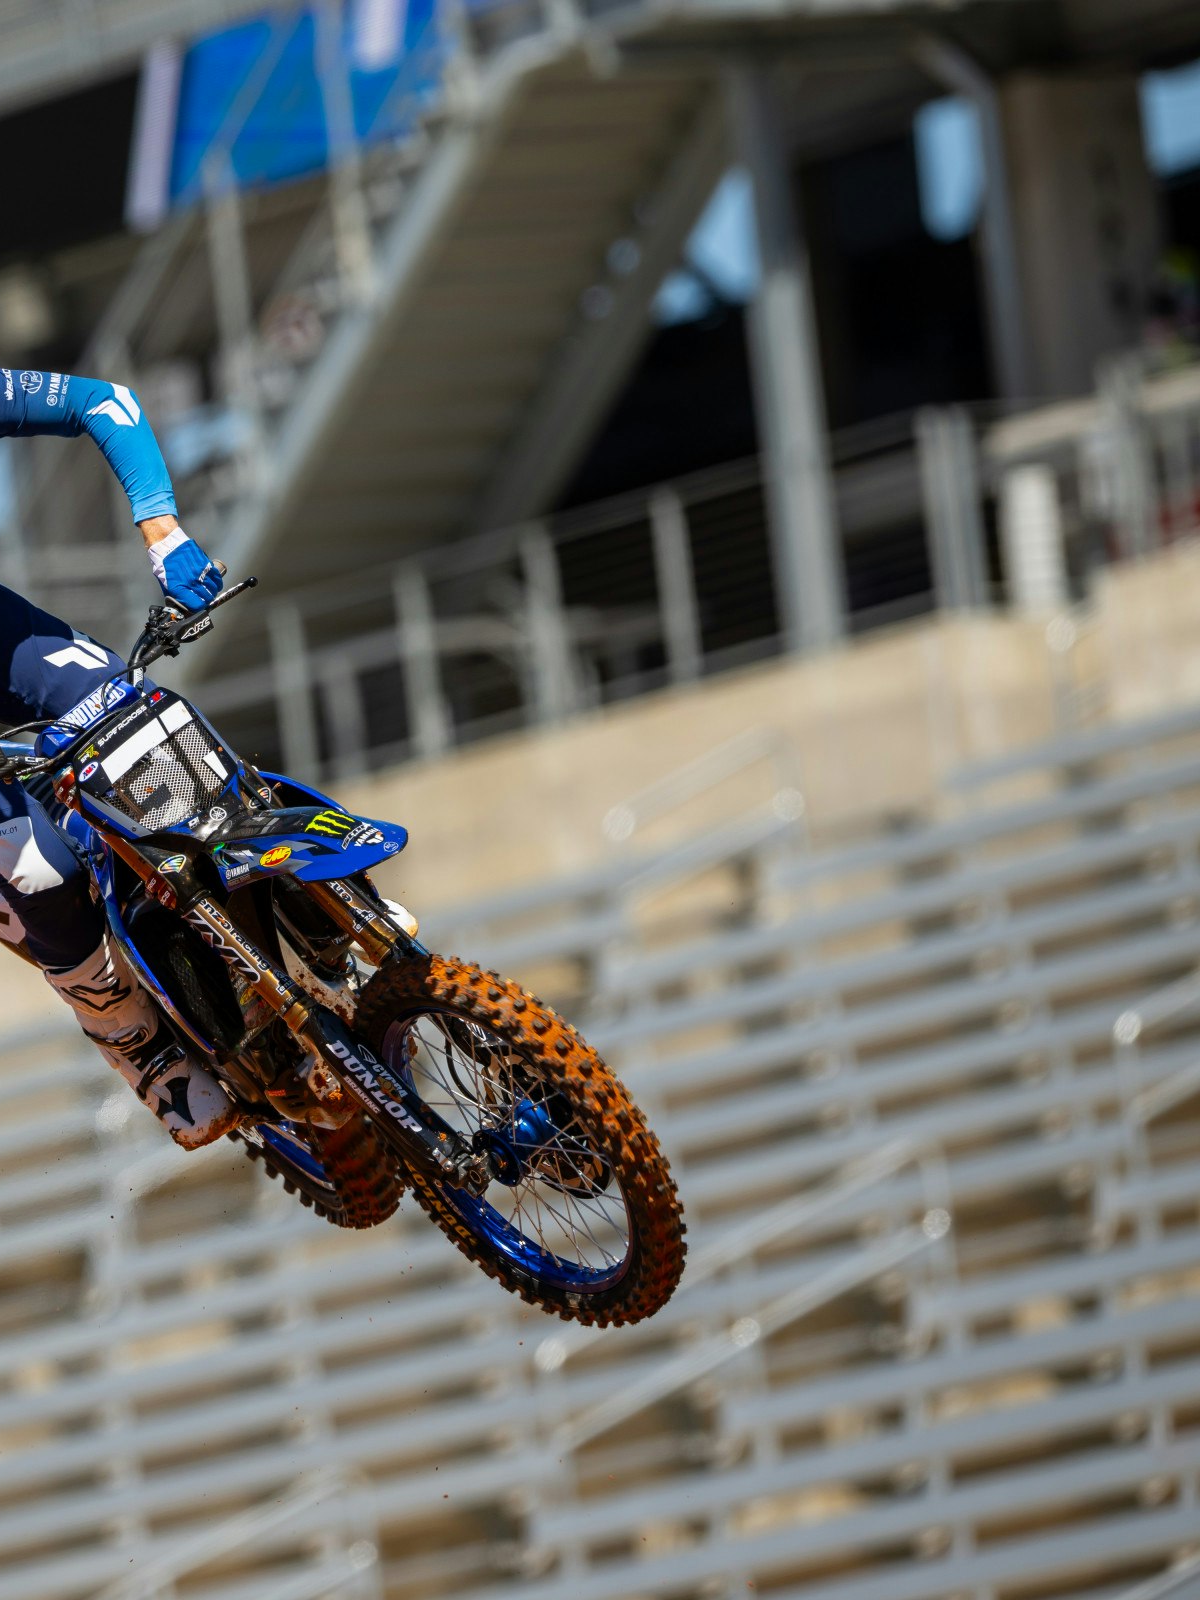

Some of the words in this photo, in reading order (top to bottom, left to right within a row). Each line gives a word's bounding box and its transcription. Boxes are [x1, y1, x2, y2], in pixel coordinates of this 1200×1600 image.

[180, 616, 211, 640] ARC
[97, 704, 148, 747] SUPERCROSS
[230, 862, 250, 878] YAMAHA
[261, 847, 291, 867] FMF
[326, 1039, 423, 1132] DUNLOP
[343, 1075, 382, 1114] BRAKING
